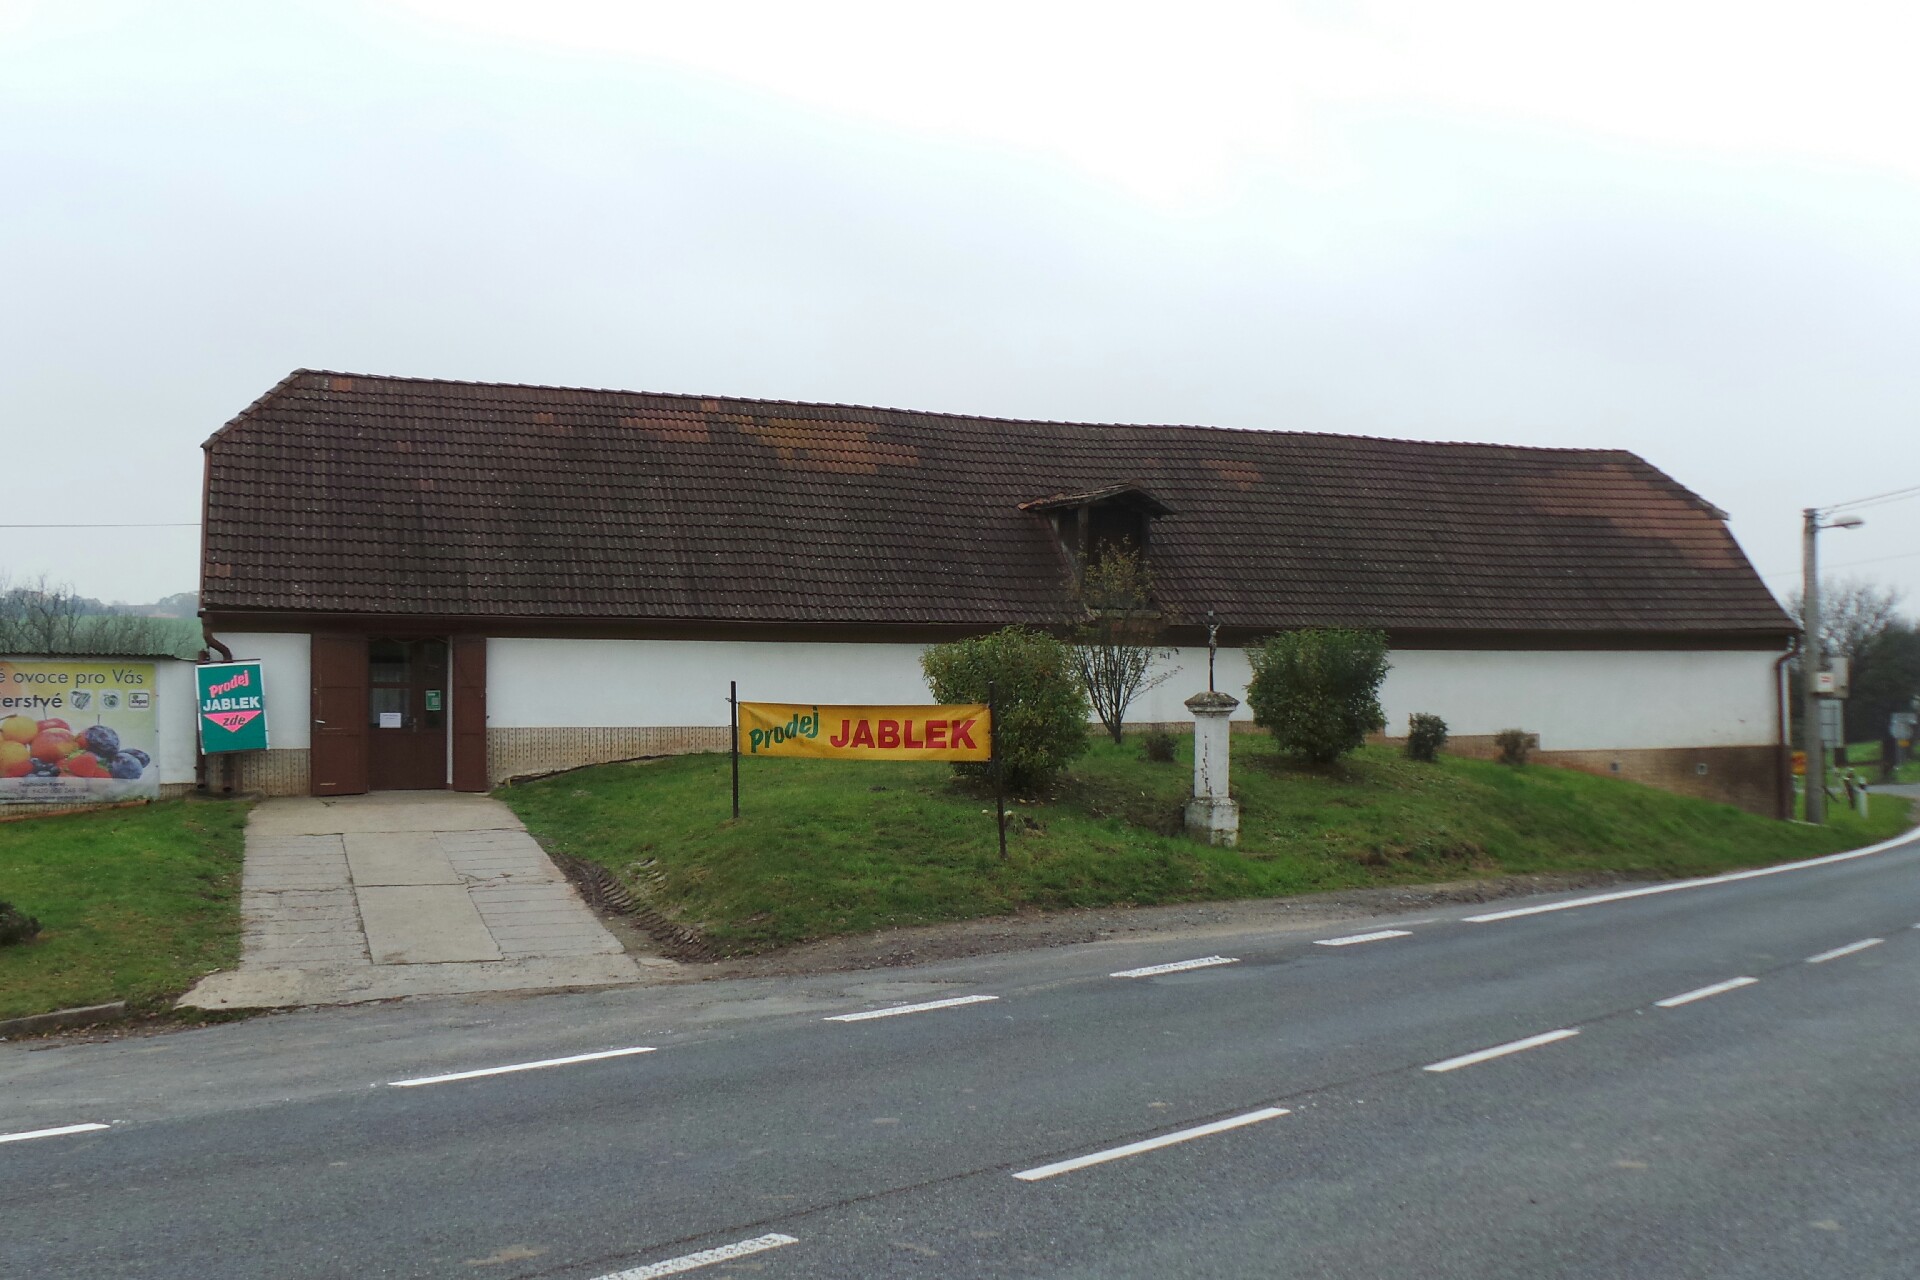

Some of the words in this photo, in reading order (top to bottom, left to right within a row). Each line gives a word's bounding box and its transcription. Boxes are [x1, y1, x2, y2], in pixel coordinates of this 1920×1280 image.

[13, 672, 69, 684] ovoce
[75, 673, 106, 688] pro
[112, 669, 143, 684] Vás
[209, 669, 249, 698] Prodej
[0, 692, 63, 708] erstvé
[202, 696, 261, 711] JABLEK
[222, 714, 246, 727] zde
[749, 705, 819, 754] Prodej
[830, 719, 978, 749] JABLEK
